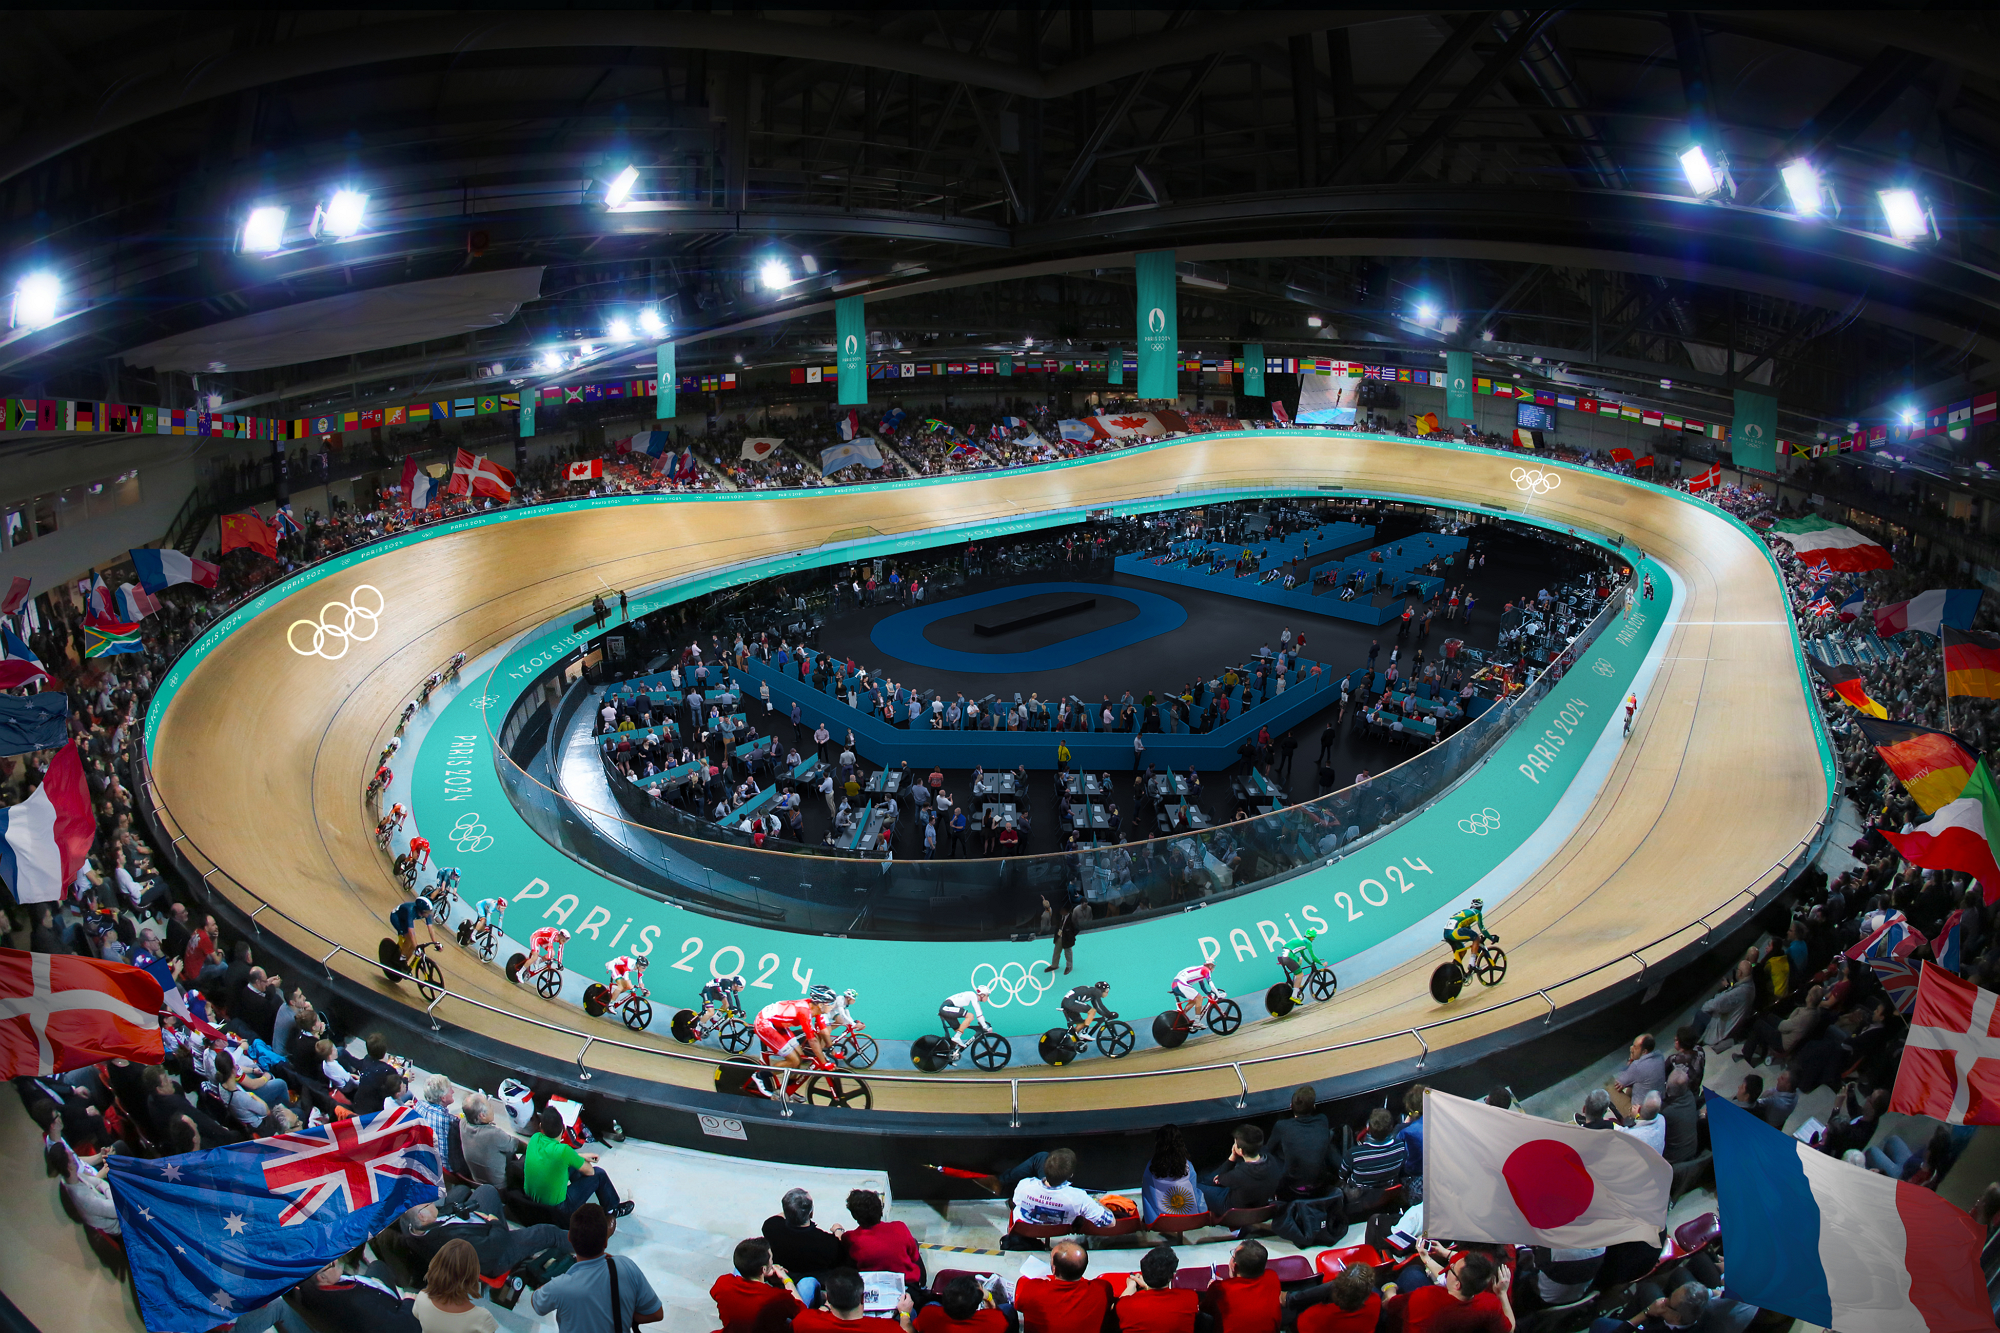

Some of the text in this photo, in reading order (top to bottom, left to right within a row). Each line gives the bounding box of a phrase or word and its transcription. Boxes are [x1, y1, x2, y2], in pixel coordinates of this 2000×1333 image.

[220, 613, 242, 635] 2024
[1628, 612, 1647, 629] 2024
[508, 651, 552, 679] 2024
[1556, 697, 1589, 736] 2024
[444, 770, 473, 802] 2024
[1334, 856, 1434, 922] 2024
[671, 936, 814, 994] 2024
